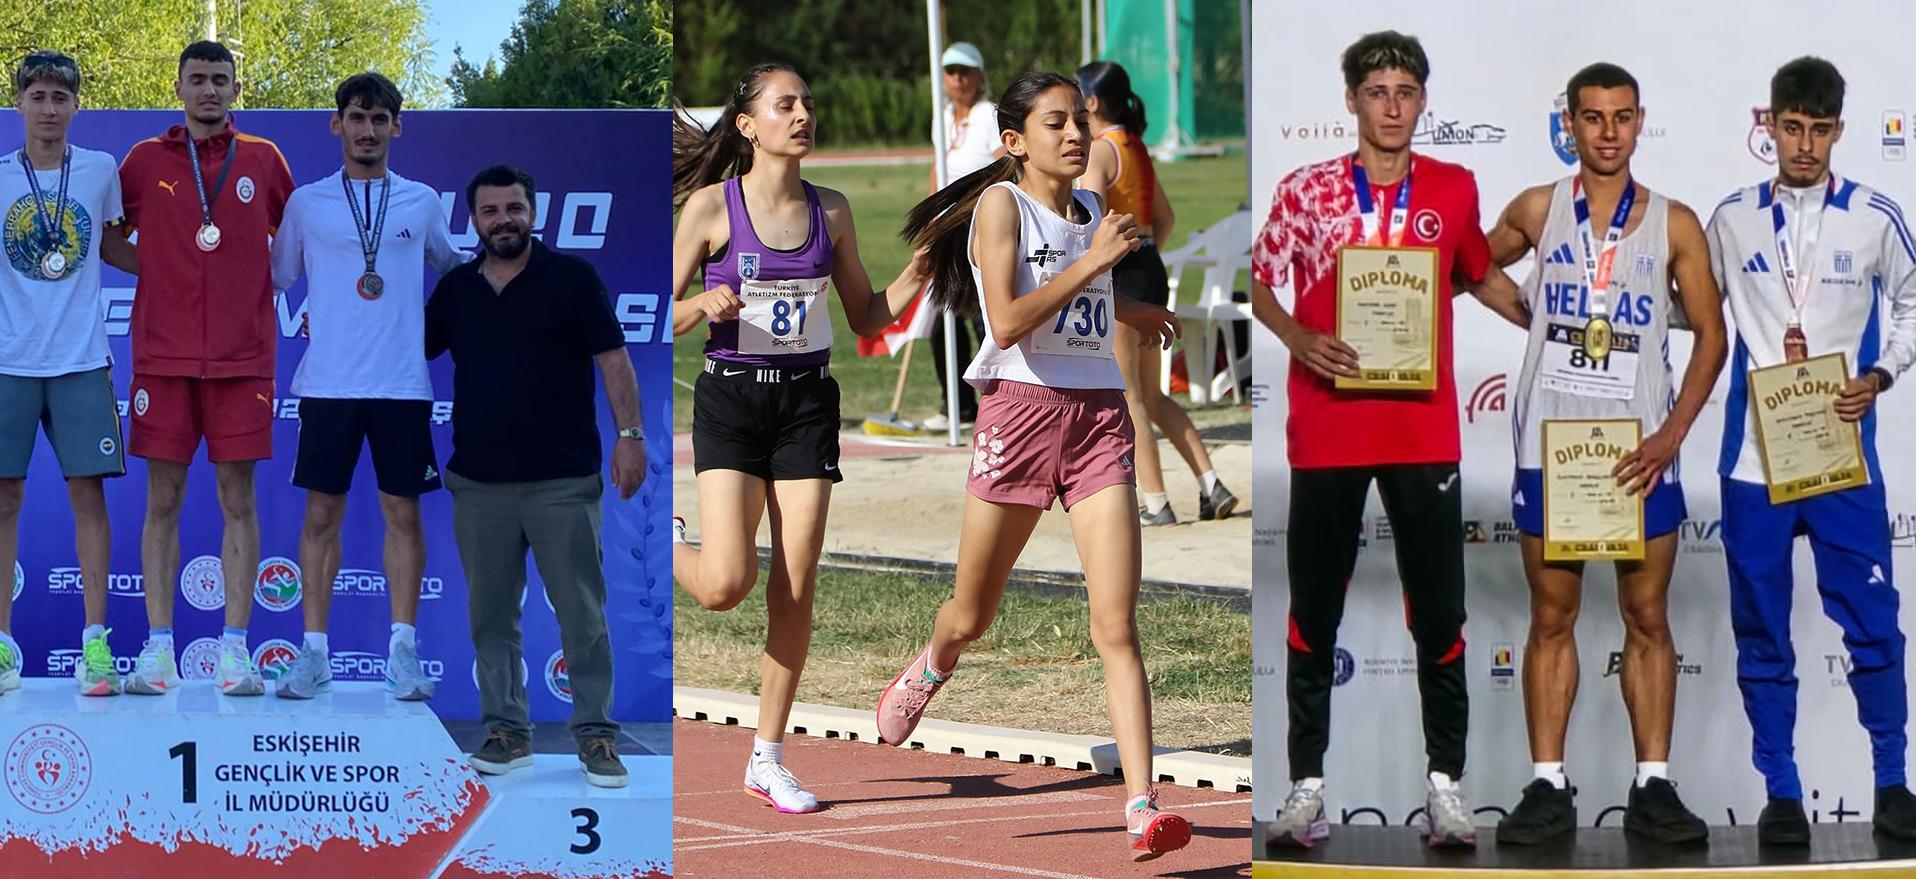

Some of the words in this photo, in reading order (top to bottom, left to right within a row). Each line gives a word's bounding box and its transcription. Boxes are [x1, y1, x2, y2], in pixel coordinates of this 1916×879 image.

[1048, 249, 1067, 257] SPOR
[1349, 270, 1428, 295] DIPLOMA
[1053, 296, 1109, 338] 730
[1544, 282, 1654, 326] HELAS
[771, 299, 806, 336] 81
[756, 369, 781, 383] NIKE
[1764, 380, 1842, 410] DIPLOMA
[1555, 442, 1622, 465] DIPLOM
[252, 731, 361, 757] ESKİŞEHİR
[169, 741, 197, 804] 1
[215, 761, 306, 787] GENÇLİK
[310, 765, 338, 783] VE
[343, 765, 400, 783] SPOR
[225, 790, 243, 812] İL
[249, 791, 390, 813] MÜDÜRLÜĞÜ
[568, 806, 602, 856] 3
